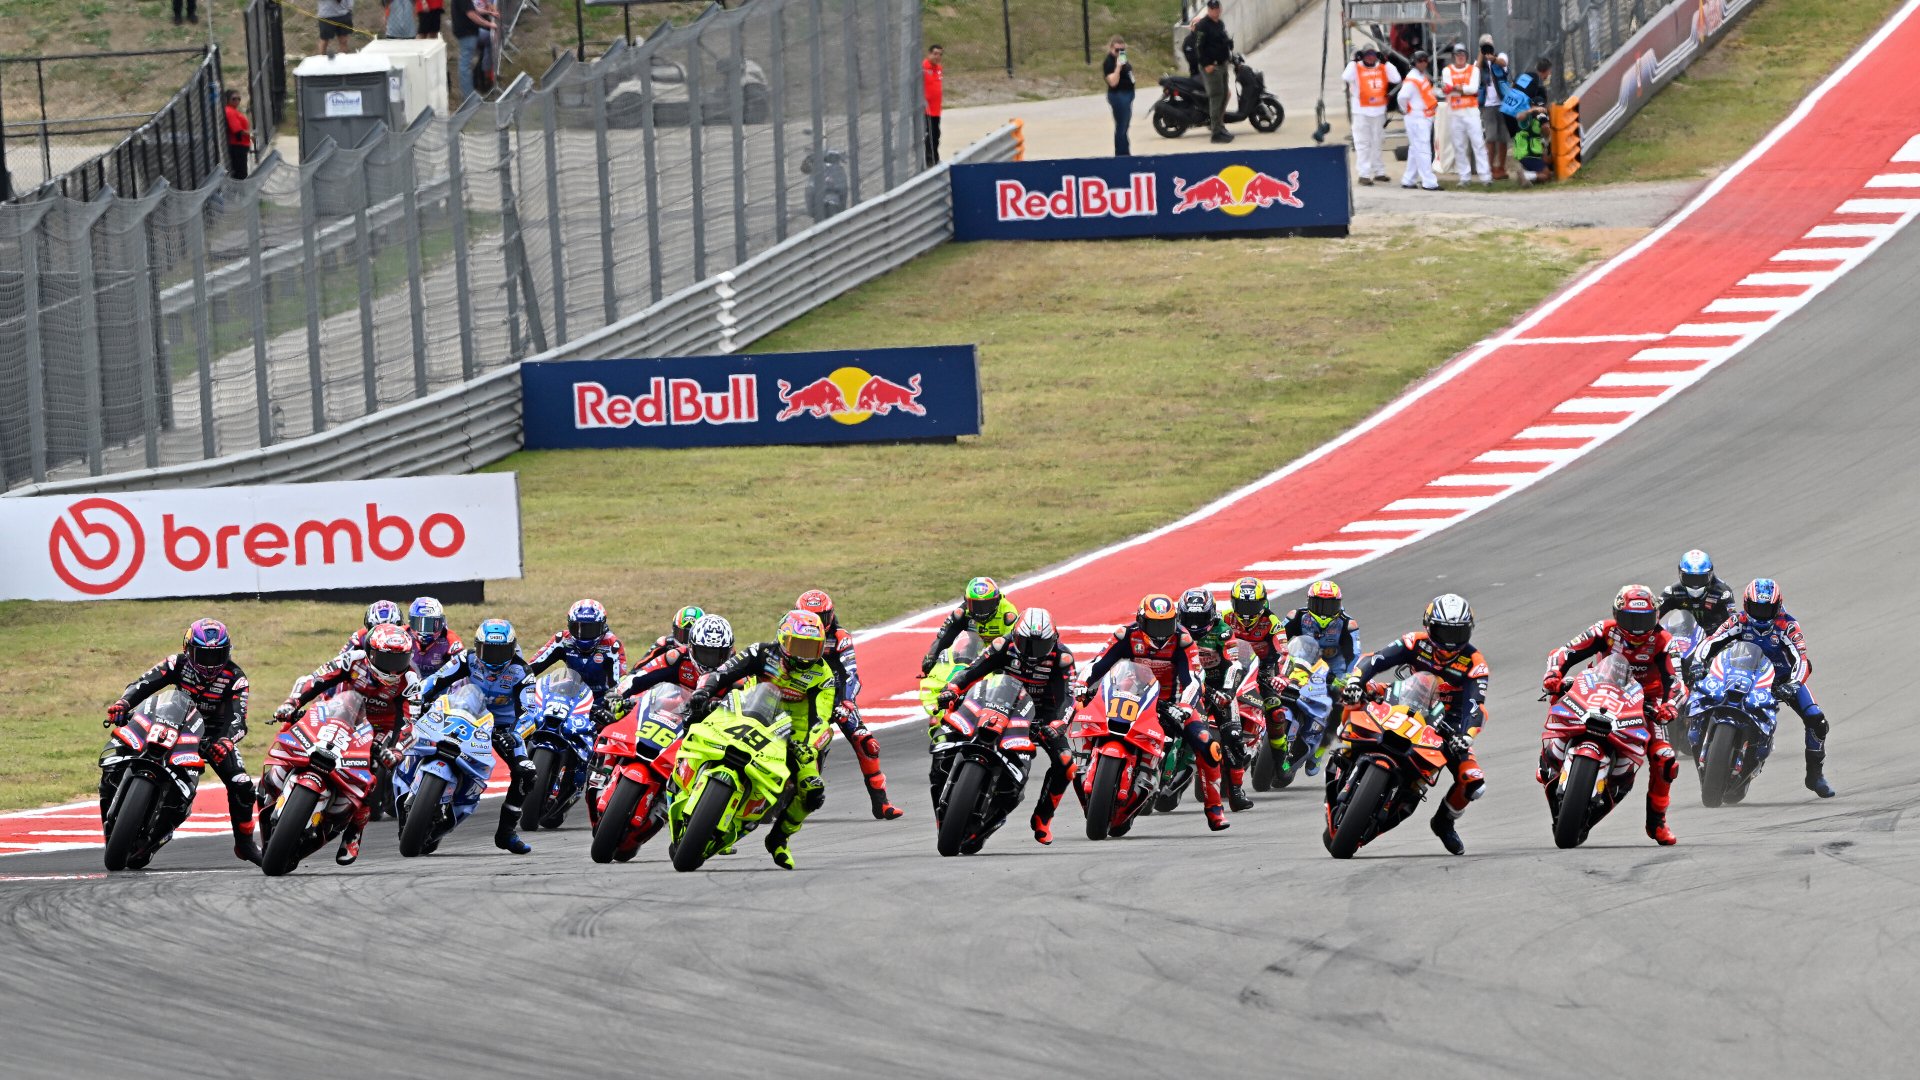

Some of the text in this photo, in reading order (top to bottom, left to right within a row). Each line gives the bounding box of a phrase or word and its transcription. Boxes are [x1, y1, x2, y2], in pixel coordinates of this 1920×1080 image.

[163, 503, 465, 572] brembo
[543, 701, 570, 719] 25
[1107, 697, 1140, 722] 10
[1562, 696, 1585, 717] Lenovo
[1586, 692, 1625, 716] 93
[439, 715, 477, 742] 73
[635, 720, 678, 749] 36
[1383, 711, 1423, 739] 37
[1616, 718, 1643, 728] Lenovo
[145, 723, 180, 750] 89
[291, 726, 312, 749] Lenovo
[317, 723, 353, 752] 63
[723, 724, 772, 752] 49
[342, 759, 368, 768] Lenovo
